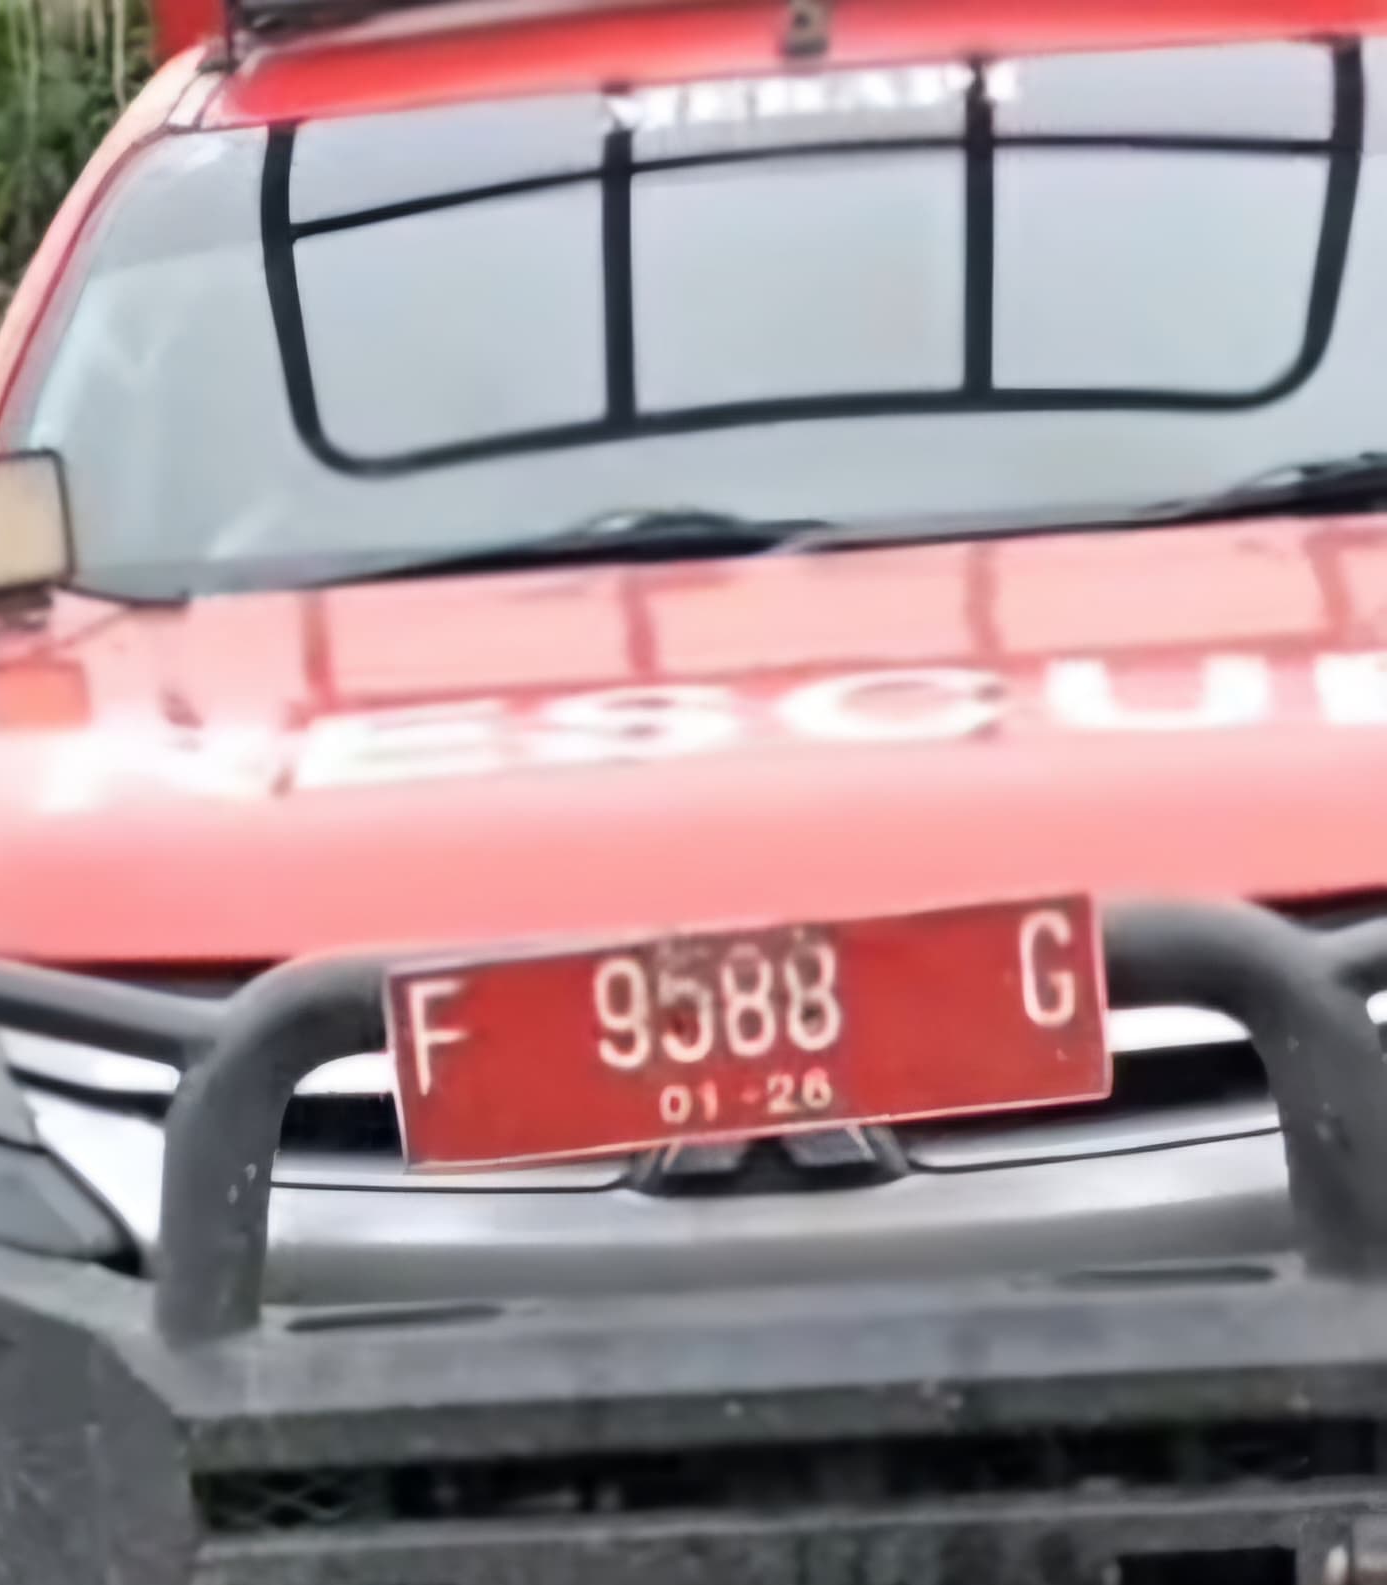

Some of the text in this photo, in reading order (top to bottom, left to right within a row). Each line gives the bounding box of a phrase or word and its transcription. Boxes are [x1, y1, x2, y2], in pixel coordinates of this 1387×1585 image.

[407, 908, 1077, 1096] F 9588 G
